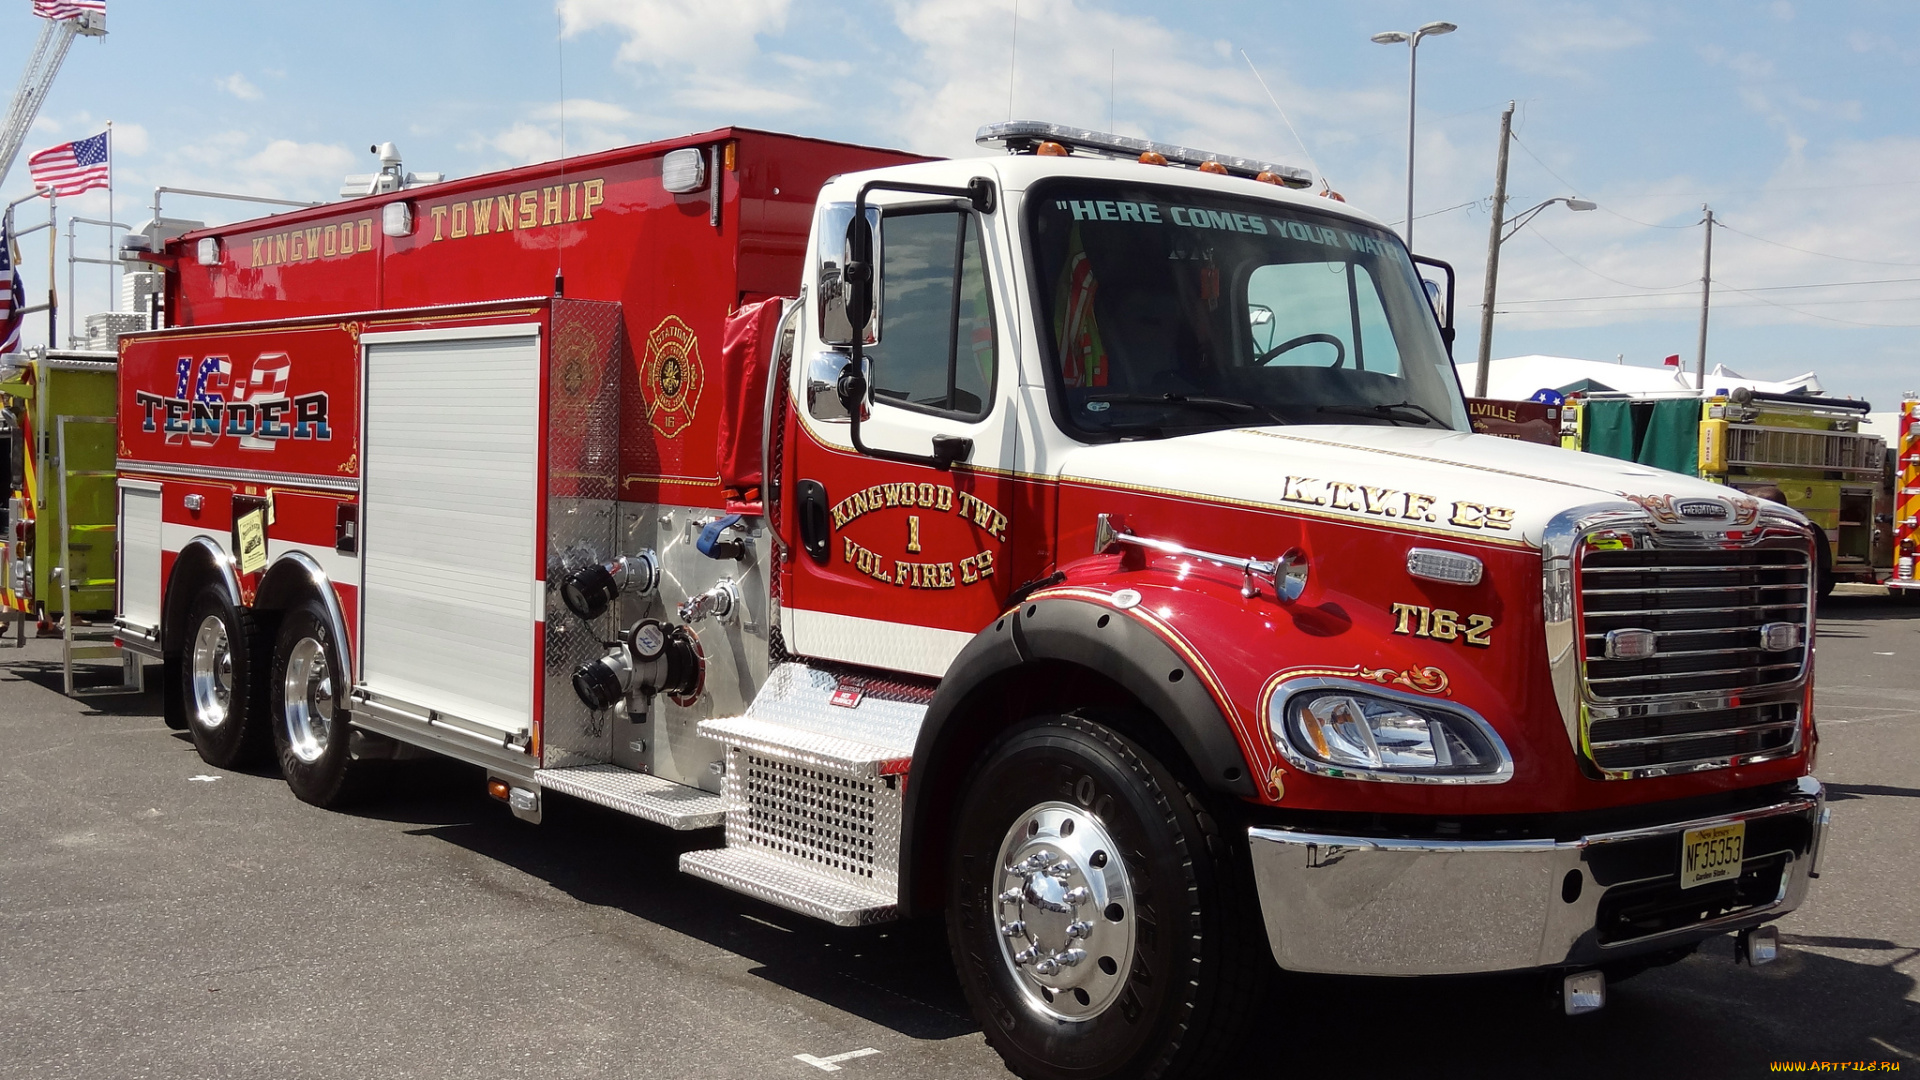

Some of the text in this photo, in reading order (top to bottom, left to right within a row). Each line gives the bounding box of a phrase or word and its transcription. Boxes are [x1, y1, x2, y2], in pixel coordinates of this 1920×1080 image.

[252, 177, 606, 268] KINGWOOD TOWNSHIP
[1056, 199, 1163, 224] "HERE
[1170, 206, 1268, 236] COMES
[1270, 218, 1342, 248] YOUR
[656, 326, 688, 345] STATION
[136, 390, 332, 440] TENDER
[164, 351, 292, 451] 16-2
[664, 416, 675, 428] 16
[829, 482, 1009, 543] KINGWOOD TWP.
[1281, 475, 1438, 523] K.T.V.F.
[907, 515, 922, 553] 1
[843, 535, 893, 583] VOL.
[894, 559, 956, 589] FIRE
[1391, 602, 1494, 646] T16-2
[1685, 835, 1742, 873] NF35353
[1696, 869, 1727, 881] Garden State
